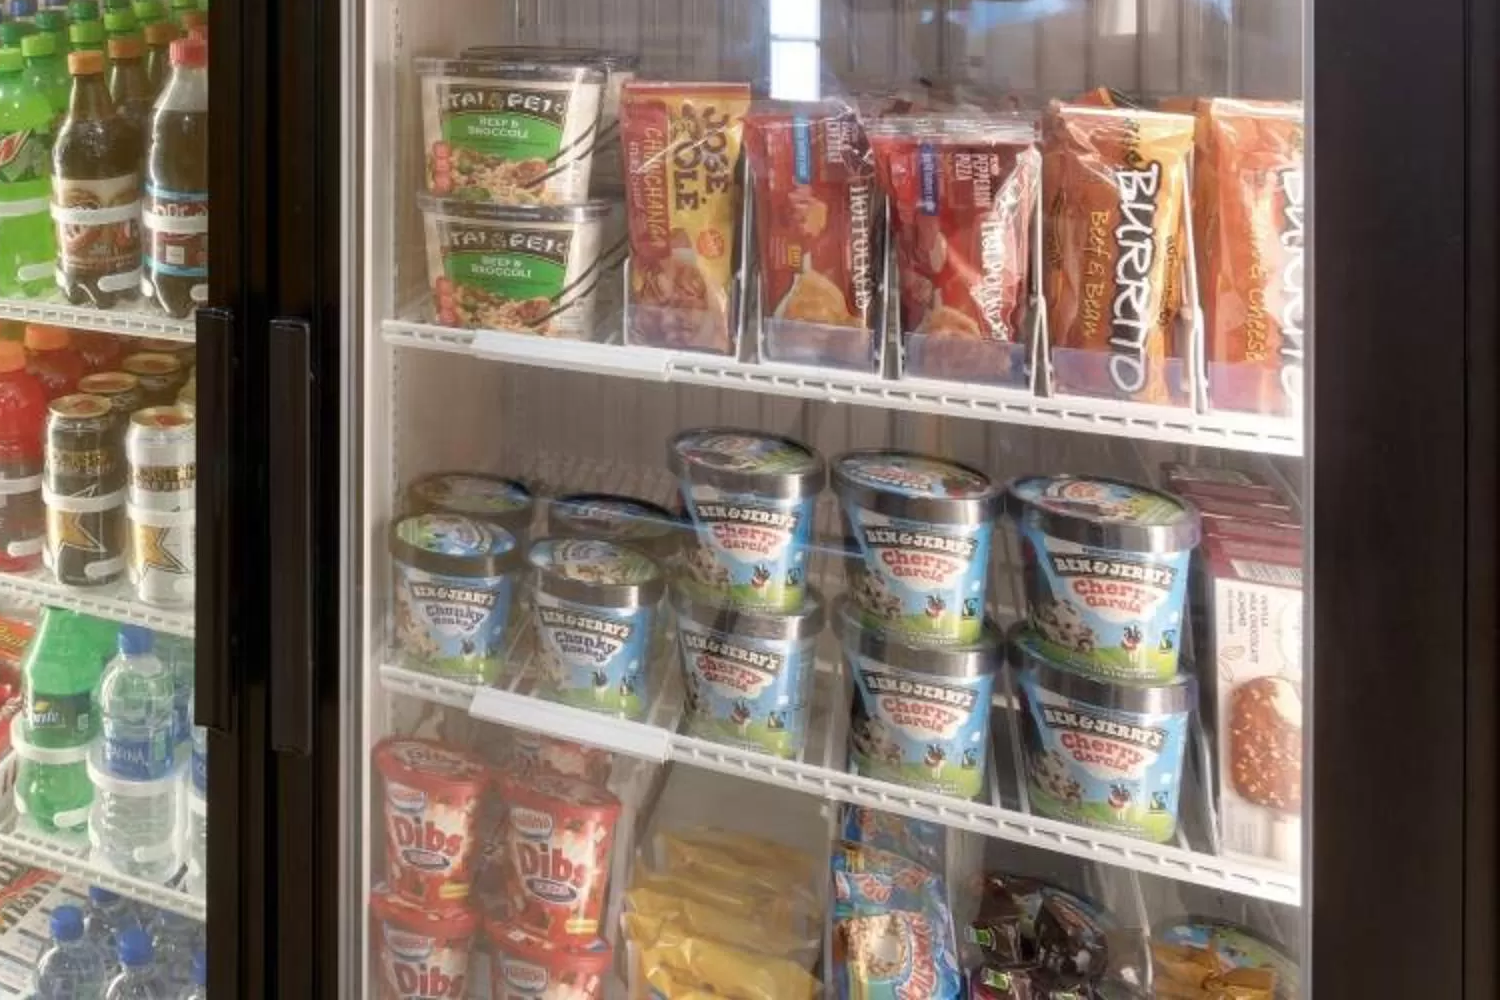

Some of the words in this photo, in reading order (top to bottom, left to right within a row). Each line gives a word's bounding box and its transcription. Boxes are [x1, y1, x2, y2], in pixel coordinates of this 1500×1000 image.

[450, 91, 484, 108] TAI
[467, 125, 529, 139] BROCCOLI
[955, 153, 972, 181] PIZZA
[451, 230, 487, 247] TAI
[1089, 211, 1111, 260] Beef
[471, 263, 532, 278] BROCCOLI
[1109, 162, 1160, 393] BURRITO
[882, 549, 956, 574] Cherry
[1061, 731, 1145, 761] Cherry
[391, 815, 463, 857] Dibs
[515, 841, 586, 889] Dibs
[393, 962, 465, 998] Dibs
